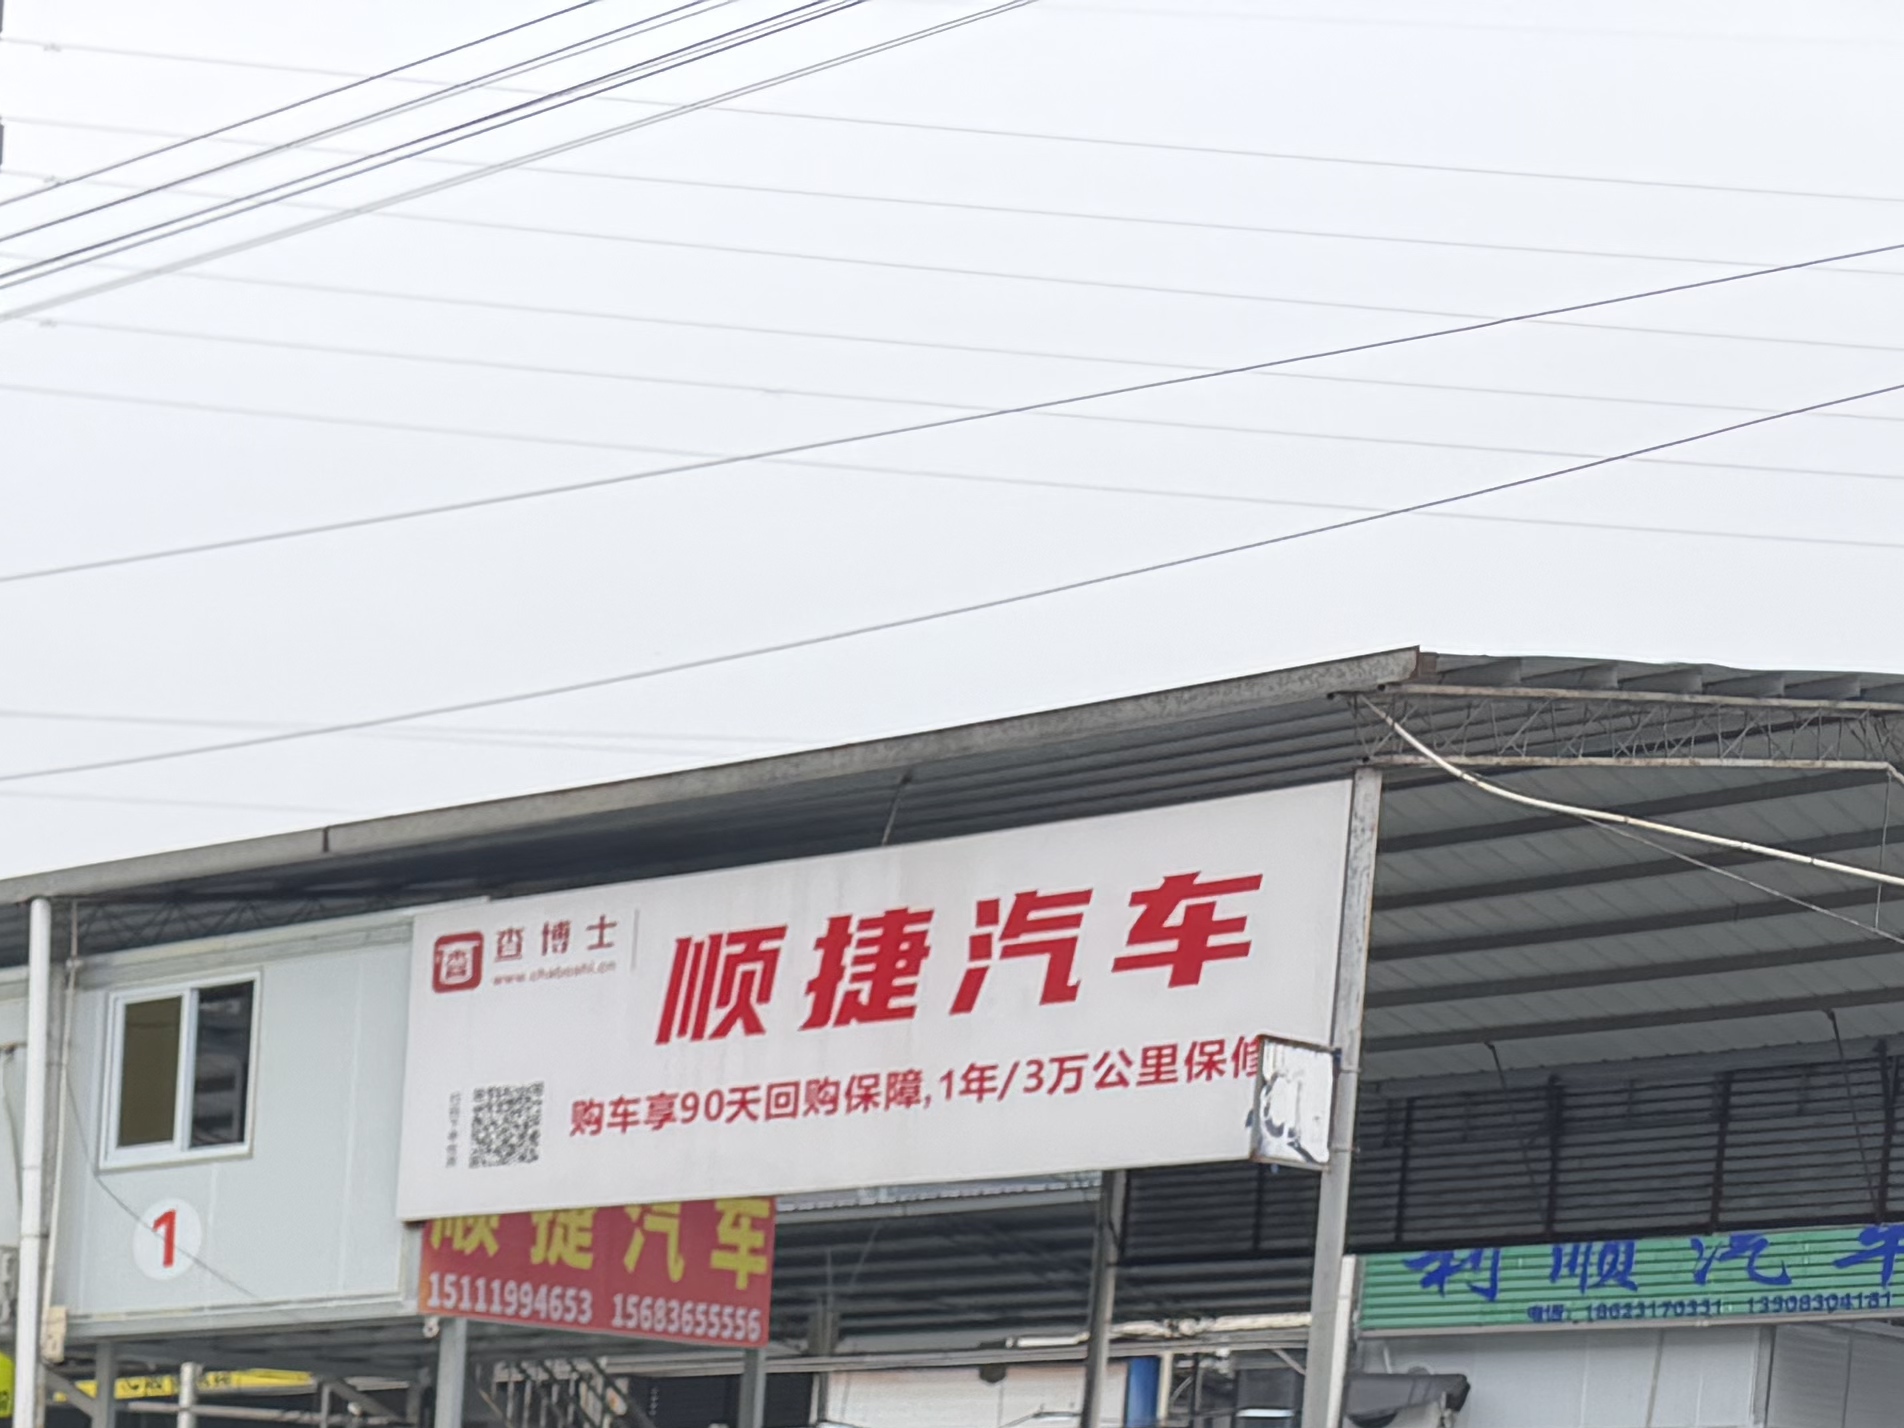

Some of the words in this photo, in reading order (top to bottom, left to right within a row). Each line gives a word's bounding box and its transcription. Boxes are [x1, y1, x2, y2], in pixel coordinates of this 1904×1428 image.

[493, 914, 618, 962] 查博士
[655, 871, 1263, 1045] 顺捷汽车
[152, 1210, 177, 1268] 1
[426, 1272, 593, 1325] 15111994653
[611, 1293, 762, 1342] 15683655556
